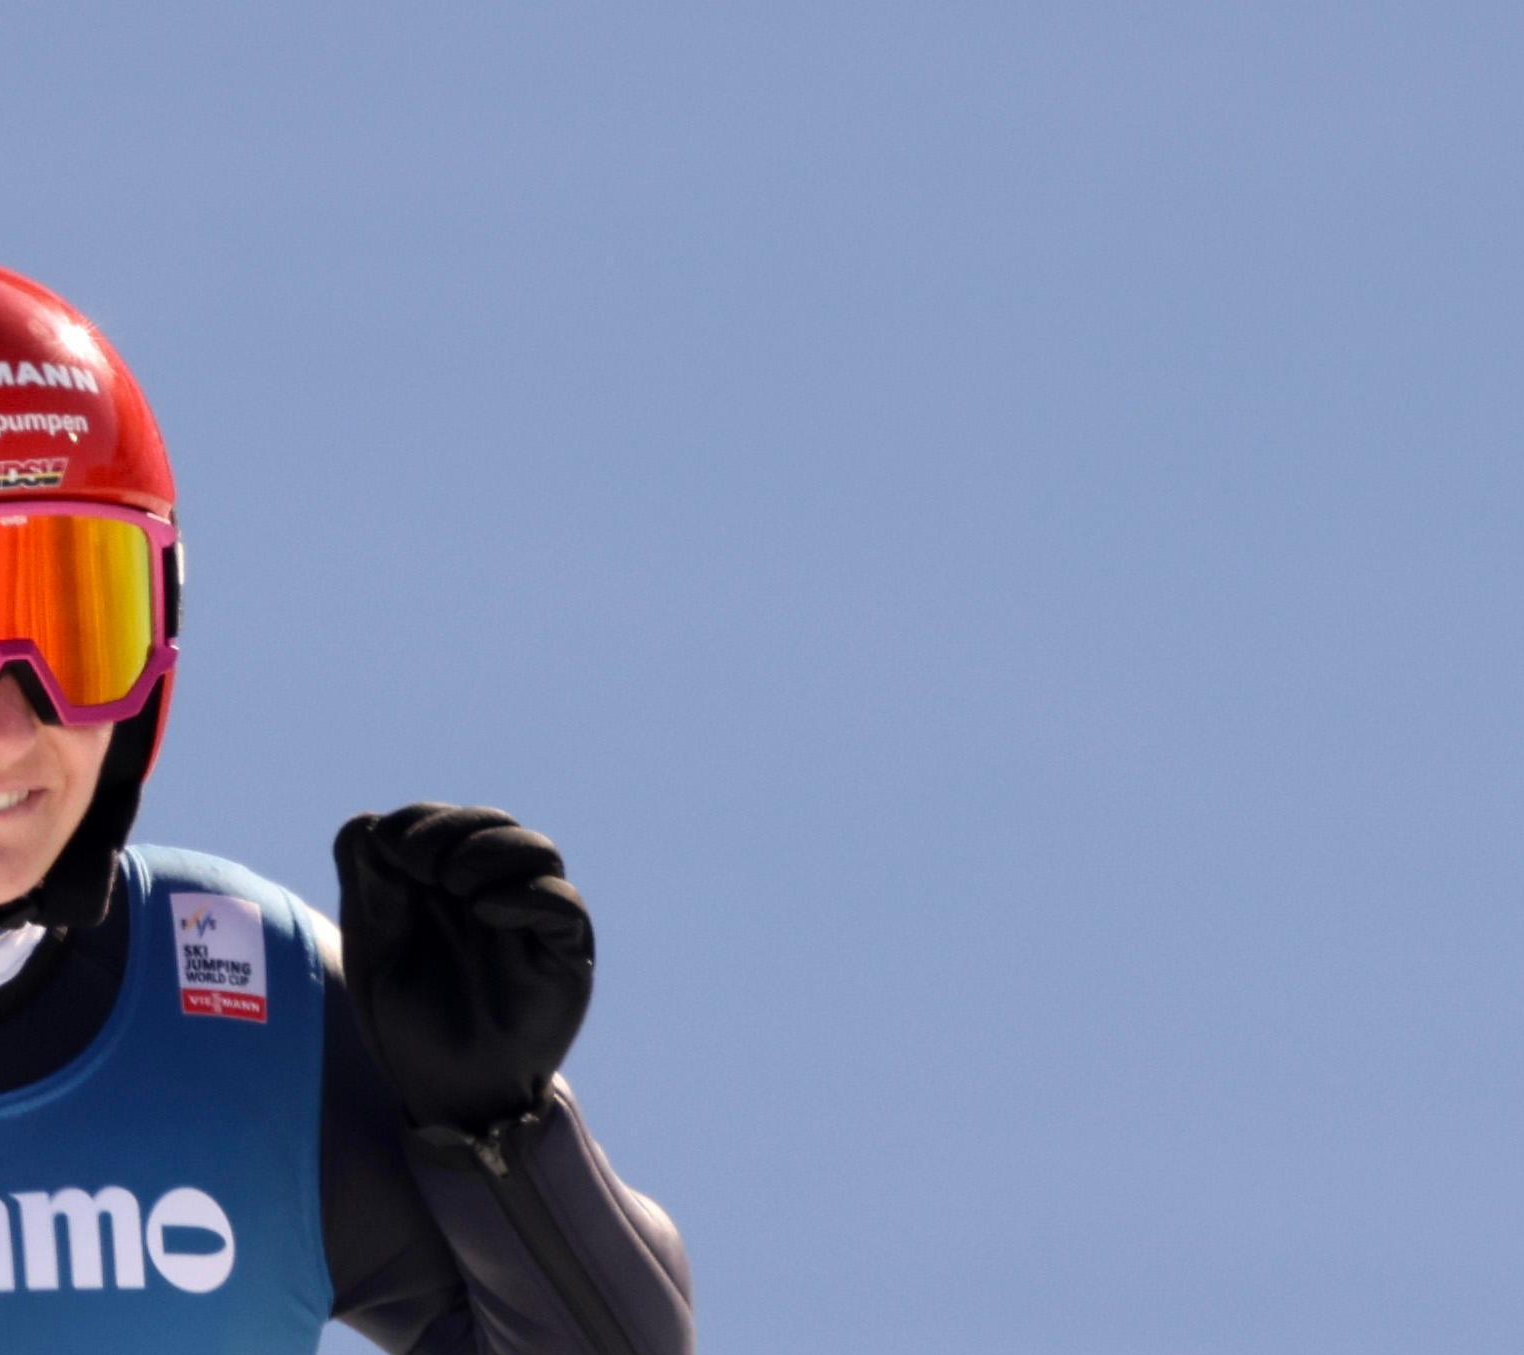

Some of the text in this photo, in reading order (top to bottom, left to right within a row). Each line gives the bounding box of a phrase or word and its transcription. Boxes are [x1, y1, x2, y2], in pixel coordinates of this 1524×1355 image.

[184, 944, 208, 959] SKI
[186, 959, 251, 976] JUMPING
[186, 972, 250, 986] WORLD CUP
